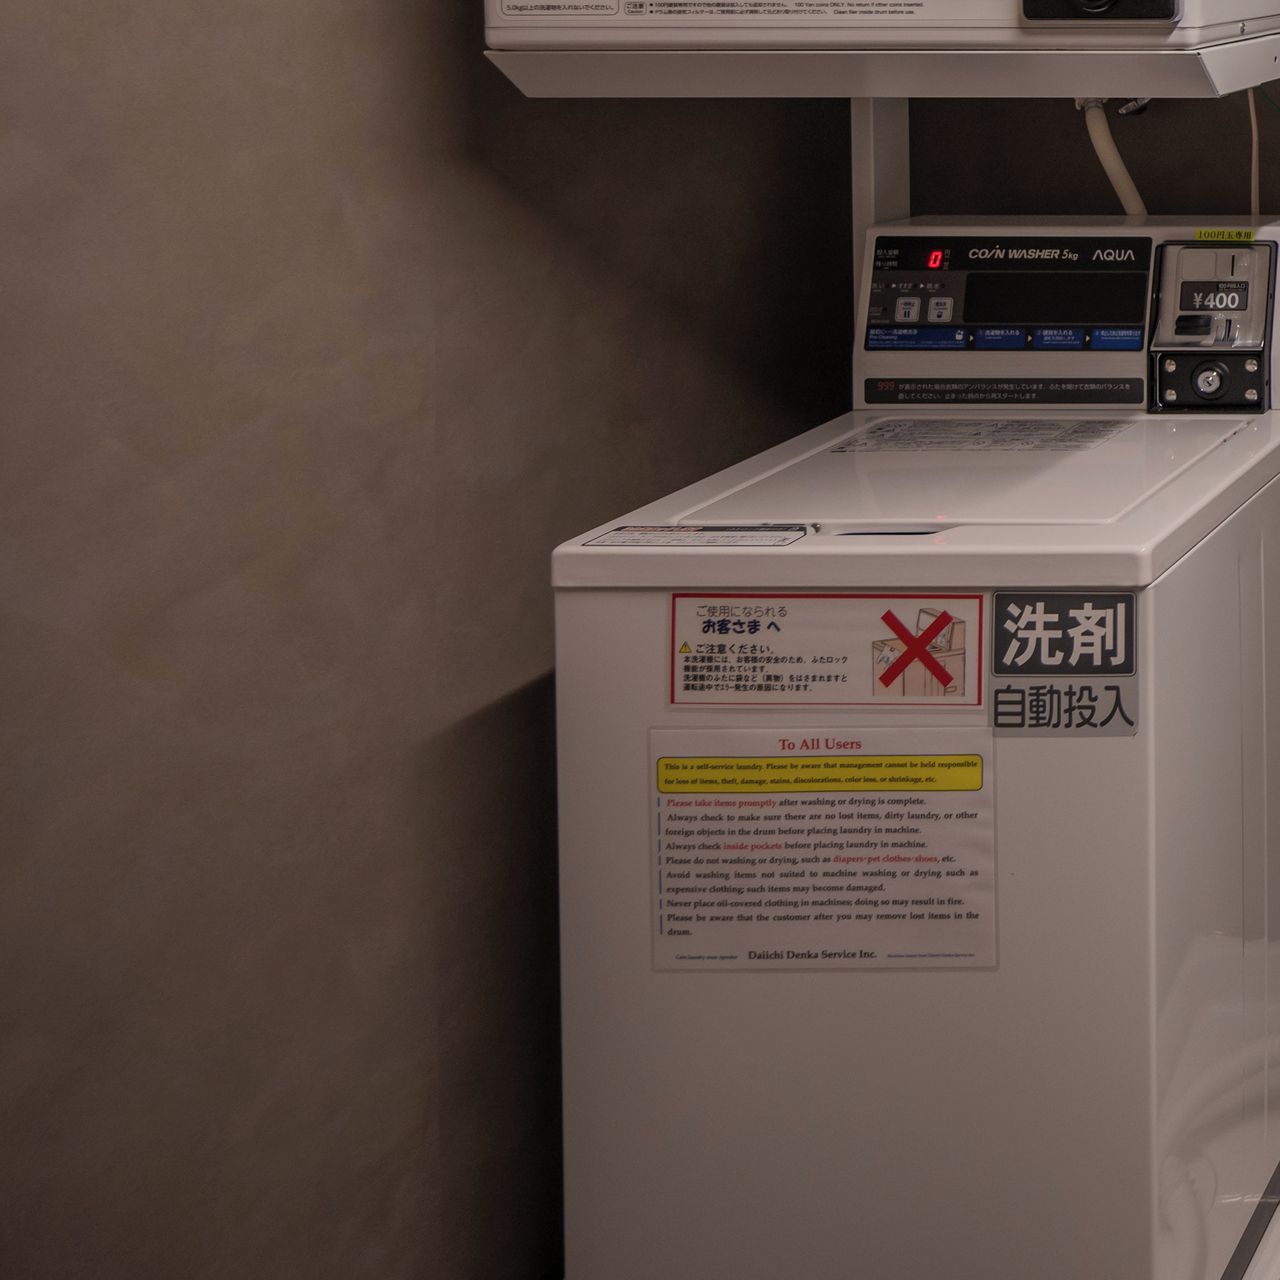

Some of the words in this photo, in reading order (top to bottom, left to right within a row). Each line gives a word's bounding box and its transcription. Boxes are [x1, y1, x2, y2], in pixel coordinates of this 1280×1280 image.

[1200, 229, 1253, 241] 100円玉専用
[928, 249, 943, 270] 0
[969, 245, 1005, 258] COIN
[1009, 248, 1059, 260] WASHER
[1062, 249, 1078, 260] 5kg
[1093, 249, 1134, 260] AQUA
[1195, 290, 1239, 310] ¥400
[697, 605, 787, 620] ご使用になられる
[1001, 600, 1127, 668] 洗剤
[696, 644, 776, 654] ご注意ください。
[994, 685, 1134, 728] 自動投入
[779, 739, 795, 750] To
[800, 737, 819, 750] All
[825, 739, 861, 749] Users
[713, 798, 738, 808] items
[739, 799, 776, 808] promptly
[801, 798, 836, 807] washing
[848, 798, 876, 808] drying
[878, 798, 885, 806] is
[887, 797, 924, 806] complete.
[694, 900, 715, 909] place
[765, 898, 799, 908] clothing
[855, 898, 879, 907] doing
[912, 896, 934, 905] result
[749, 949, 786, 960] Daiichi
[787, 951, 818, 959] Denka
[860, 950, 876, 958] Inc.
